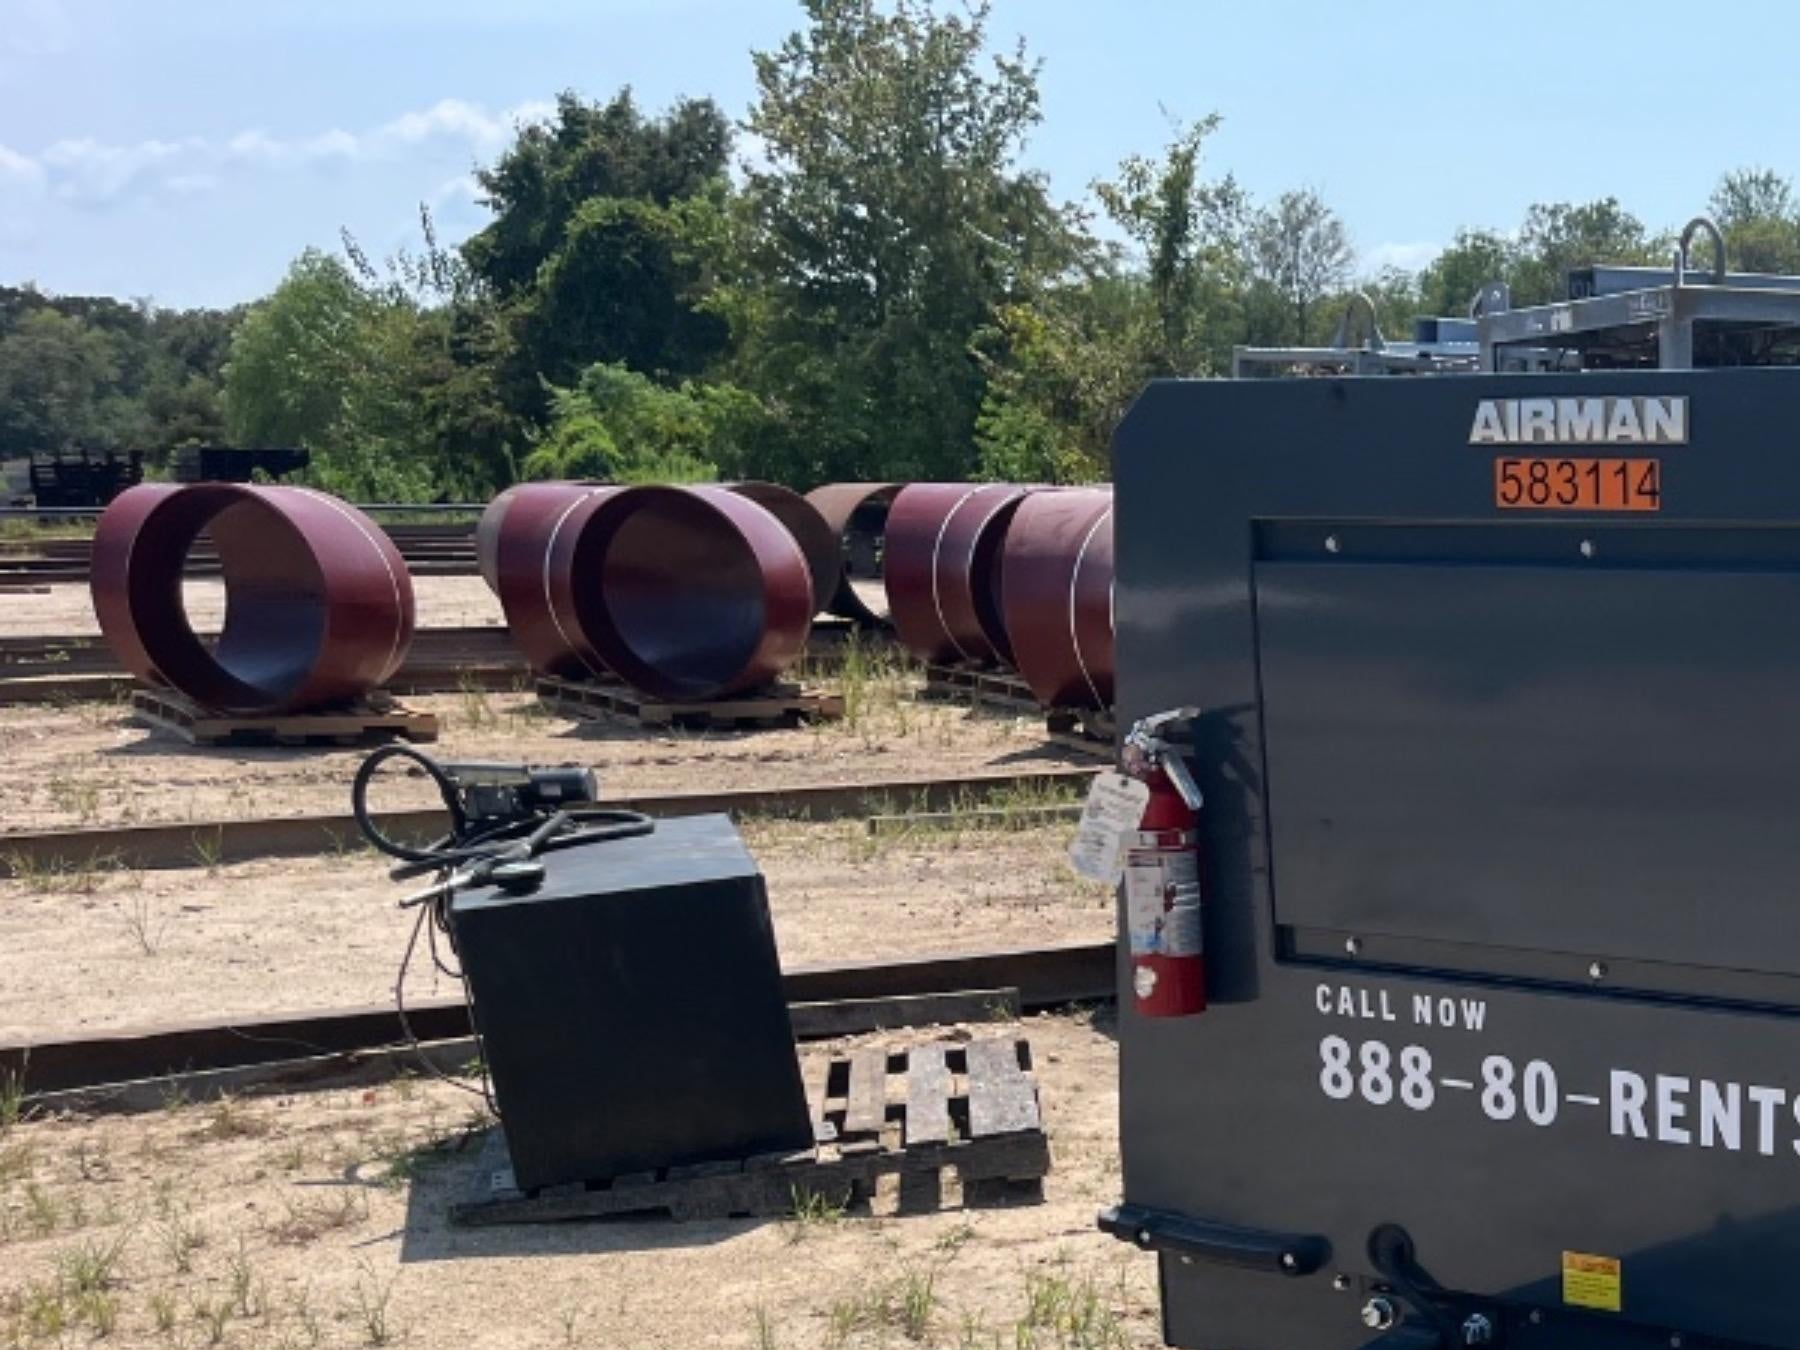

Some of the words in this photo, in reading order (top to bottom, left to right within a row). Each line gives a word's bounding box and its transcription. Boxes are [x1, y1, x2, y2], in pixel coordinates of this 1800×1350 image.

[1469, 396, 1690, 445] AIRMAN
[1499, 459, 1660, 507] 583114
[1316, 983, 1396, 1022] CALL
[1412, 994, 1487, 1031] NOW
